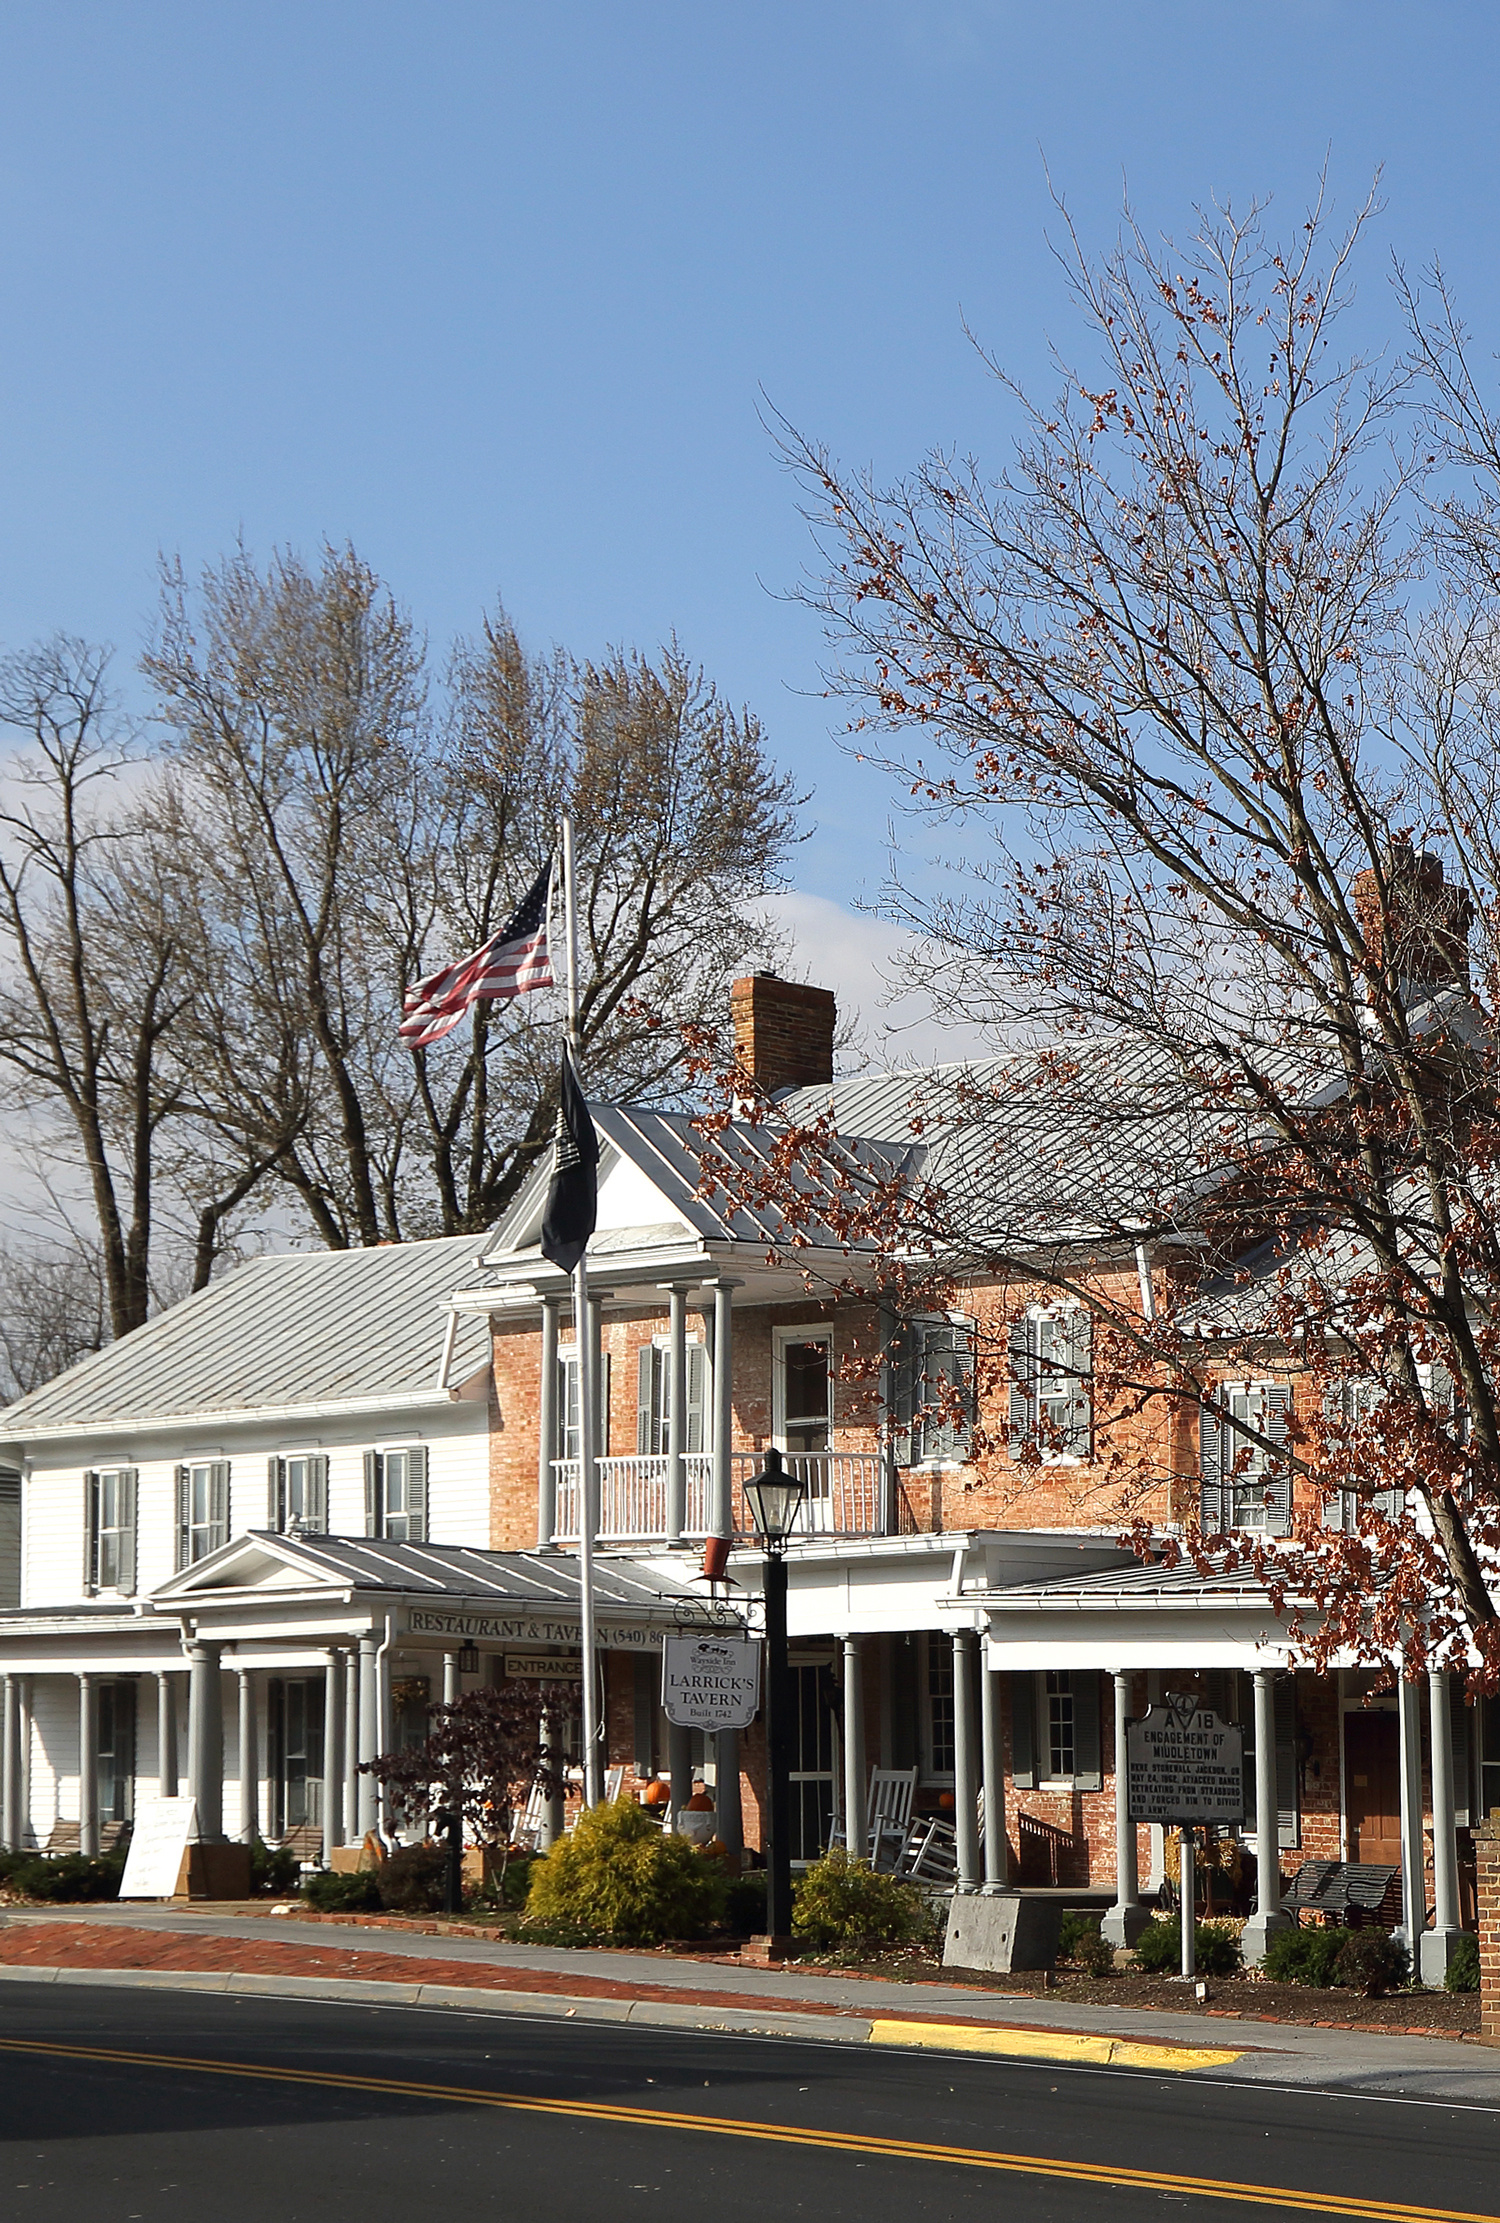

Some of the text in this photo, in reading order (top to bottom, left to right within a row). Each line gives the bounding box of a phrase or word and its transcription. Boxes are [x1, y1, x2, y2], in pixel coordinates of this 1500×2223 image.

[413, 1613, 668, 1646] RESTAURANT & TAVEN (540) 86
[507, 1660, 582, 1674] ENTRANCE
[690, 1656, 736, 1666] Wayside Inn
[670, 1674, 754, 1691] LARRICK'S
[680, 1691, 743, 1706] TAVERN
[690, 1708, 732, 1719] Built 1742
[1165, 1711, 1175, 1729] A
[1144, 1731, 1225, 1746] ENGAGEMENT OF
[1153, 1745, 1217, 1760] MIDDLETOWN
[1152, 1764, 1191, 1773] STONEWALL
[1130, 1773, 1144, 1782] MAY
[1183, 1776, 1216, 1785] ATTACKED
[1131, 1784, 1174, 1793] RETREATING
[1178, 1785, 1196, 1795] FROM
[1131, 1795, 1146, 1804] AND
[1151, 1796, 1180, 1804] FORCED
[1203, 1797, 1212, 1805] TO
[1131, 1805, 1144, 1814] HIS
